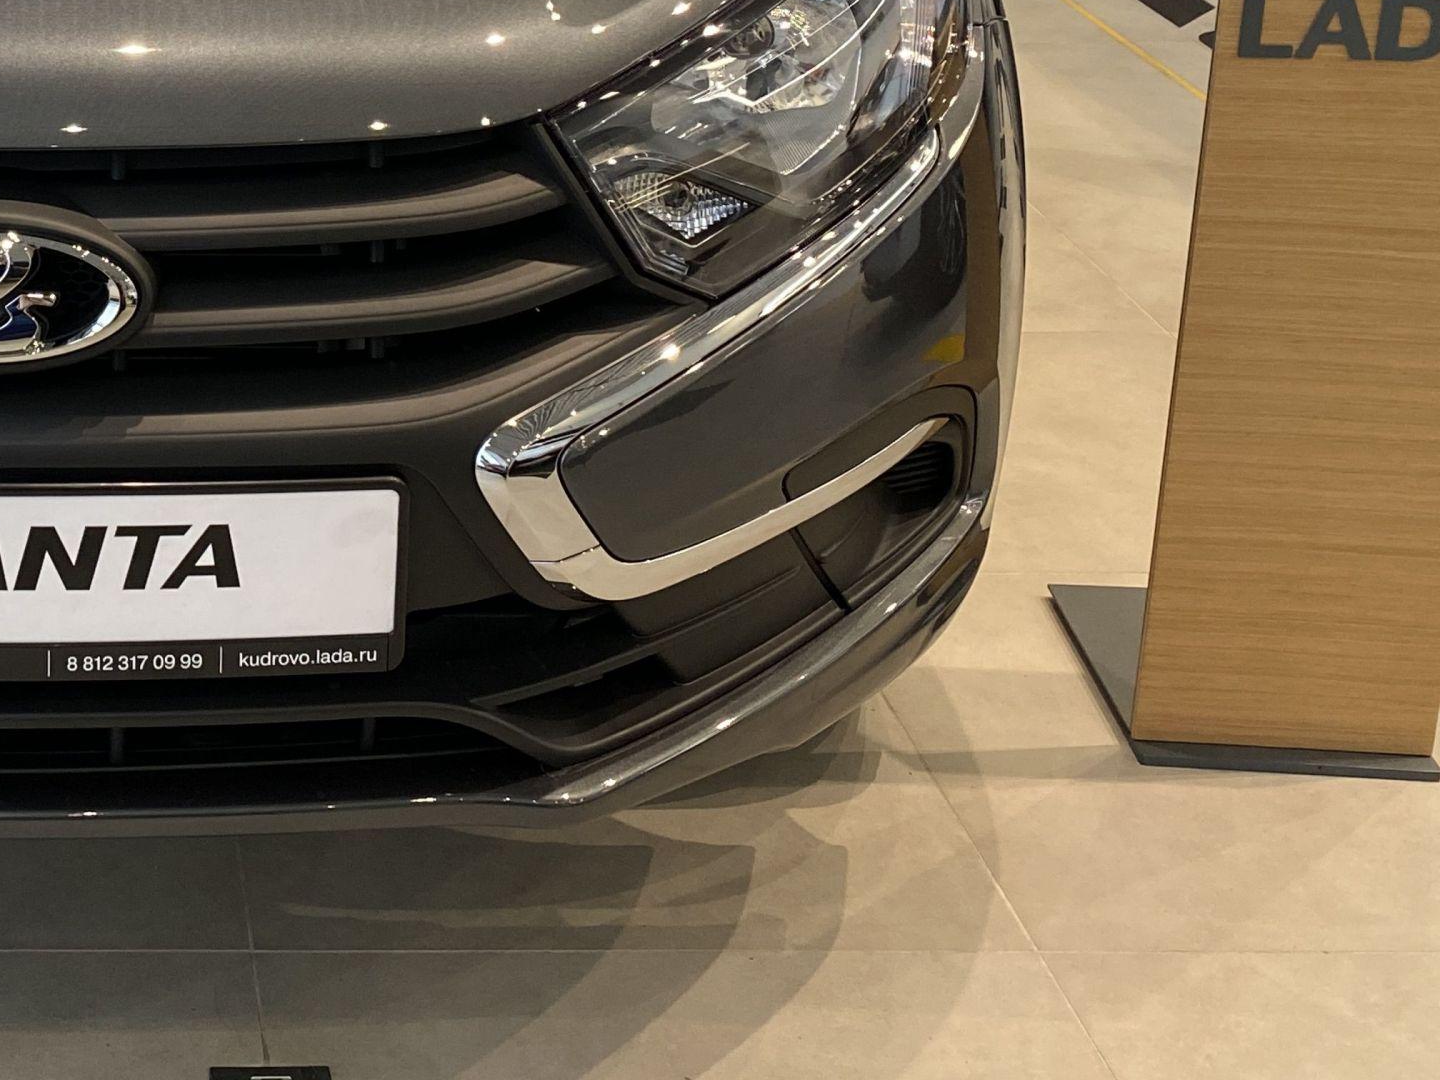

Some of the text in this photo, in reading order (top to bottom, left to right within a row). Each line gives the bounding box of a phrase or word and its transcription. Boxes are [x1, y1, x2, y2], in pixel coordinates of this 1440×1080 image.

[66, 653, 203, 671] 8 812 317 09 99
[238, 648, 377, 667] kudrovo.lada.ru
